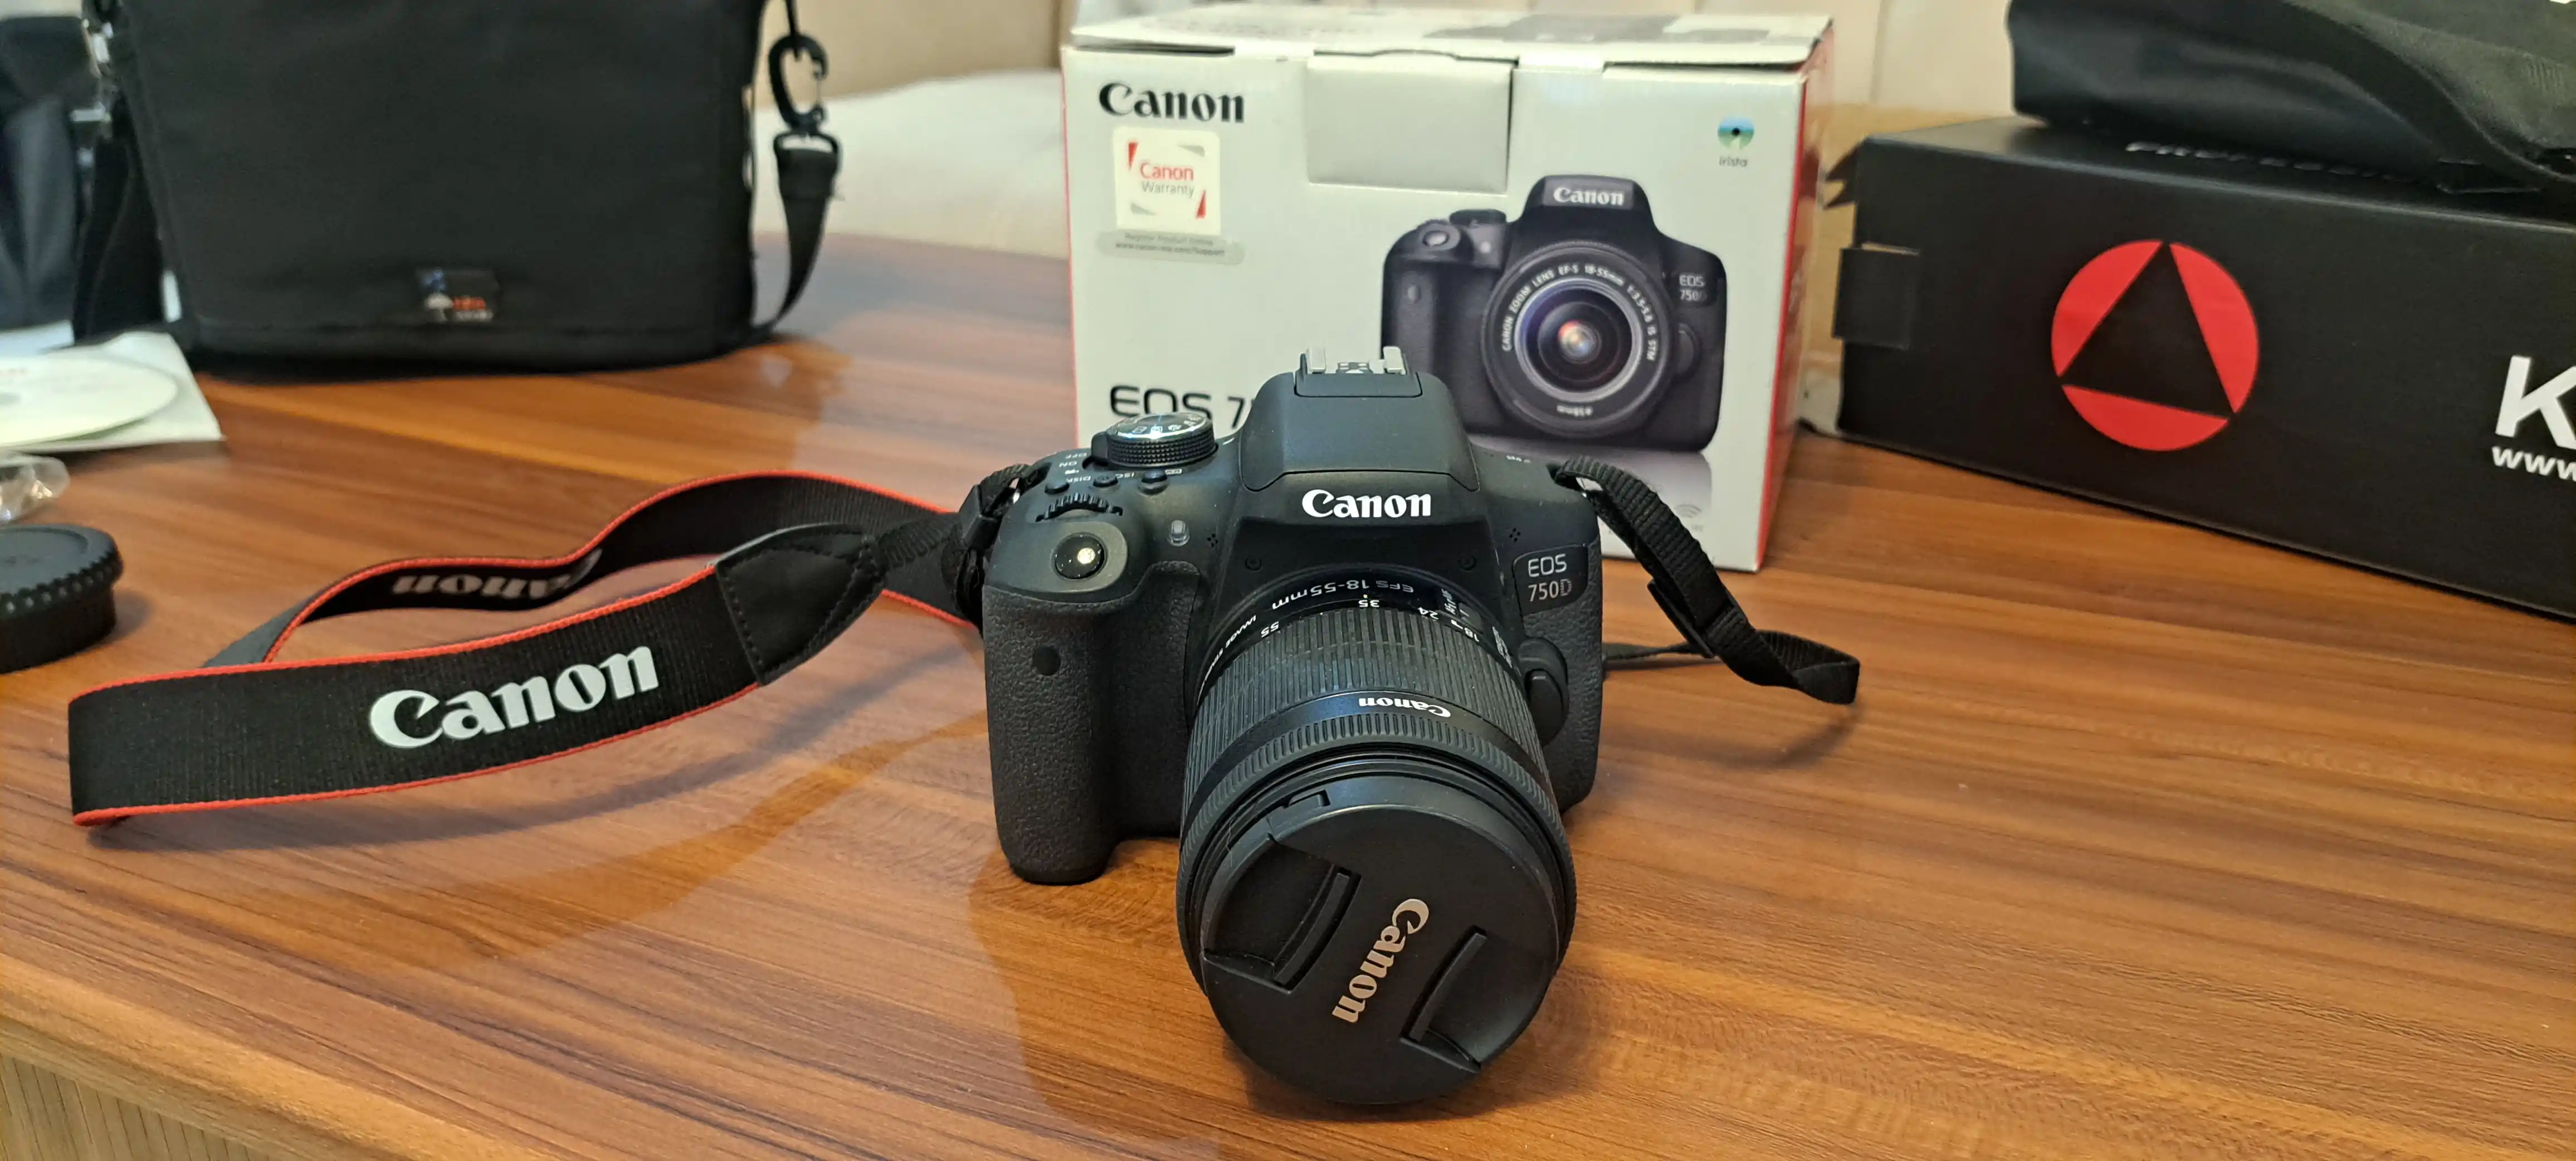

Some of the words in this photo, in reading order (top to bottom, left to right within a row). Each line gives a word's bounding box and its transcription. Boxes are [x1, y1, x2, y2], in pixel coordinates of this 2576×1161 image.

[1099, 82, 1244, 123] Canon
[1140, 162, 1194, 181] Canon
[1141, 181, 1194, 199] Warranty
[1553, 187, 1624, 205] Canon
[1679, 275, 1705, 287] EOS
[1502, 316, 1514, 352] CANON
[1509, 285, 1531, 313] ZOOM
[1531, 269, 1555, 287] LENS
[1110, 385, 1212, 419] EOS
[2495, 355, 2576, 450] K
[1302, 489, 1431, 518] Canon
[1528, 553, 1567, 577] EOS
[1272, 579, 1370, 609] 18-55mm
[1528, 579, 1572, 602] 750D
[1358, 599, 1380, 608] 35
[1418, 607, 1438, 619] 24
[1261, 621, 1279, 638] 55
[368, 645, 660, 749] Canon
[1358, 696, 1451, 719] Canon
[1331, 898, 1430, 1023] Canon
